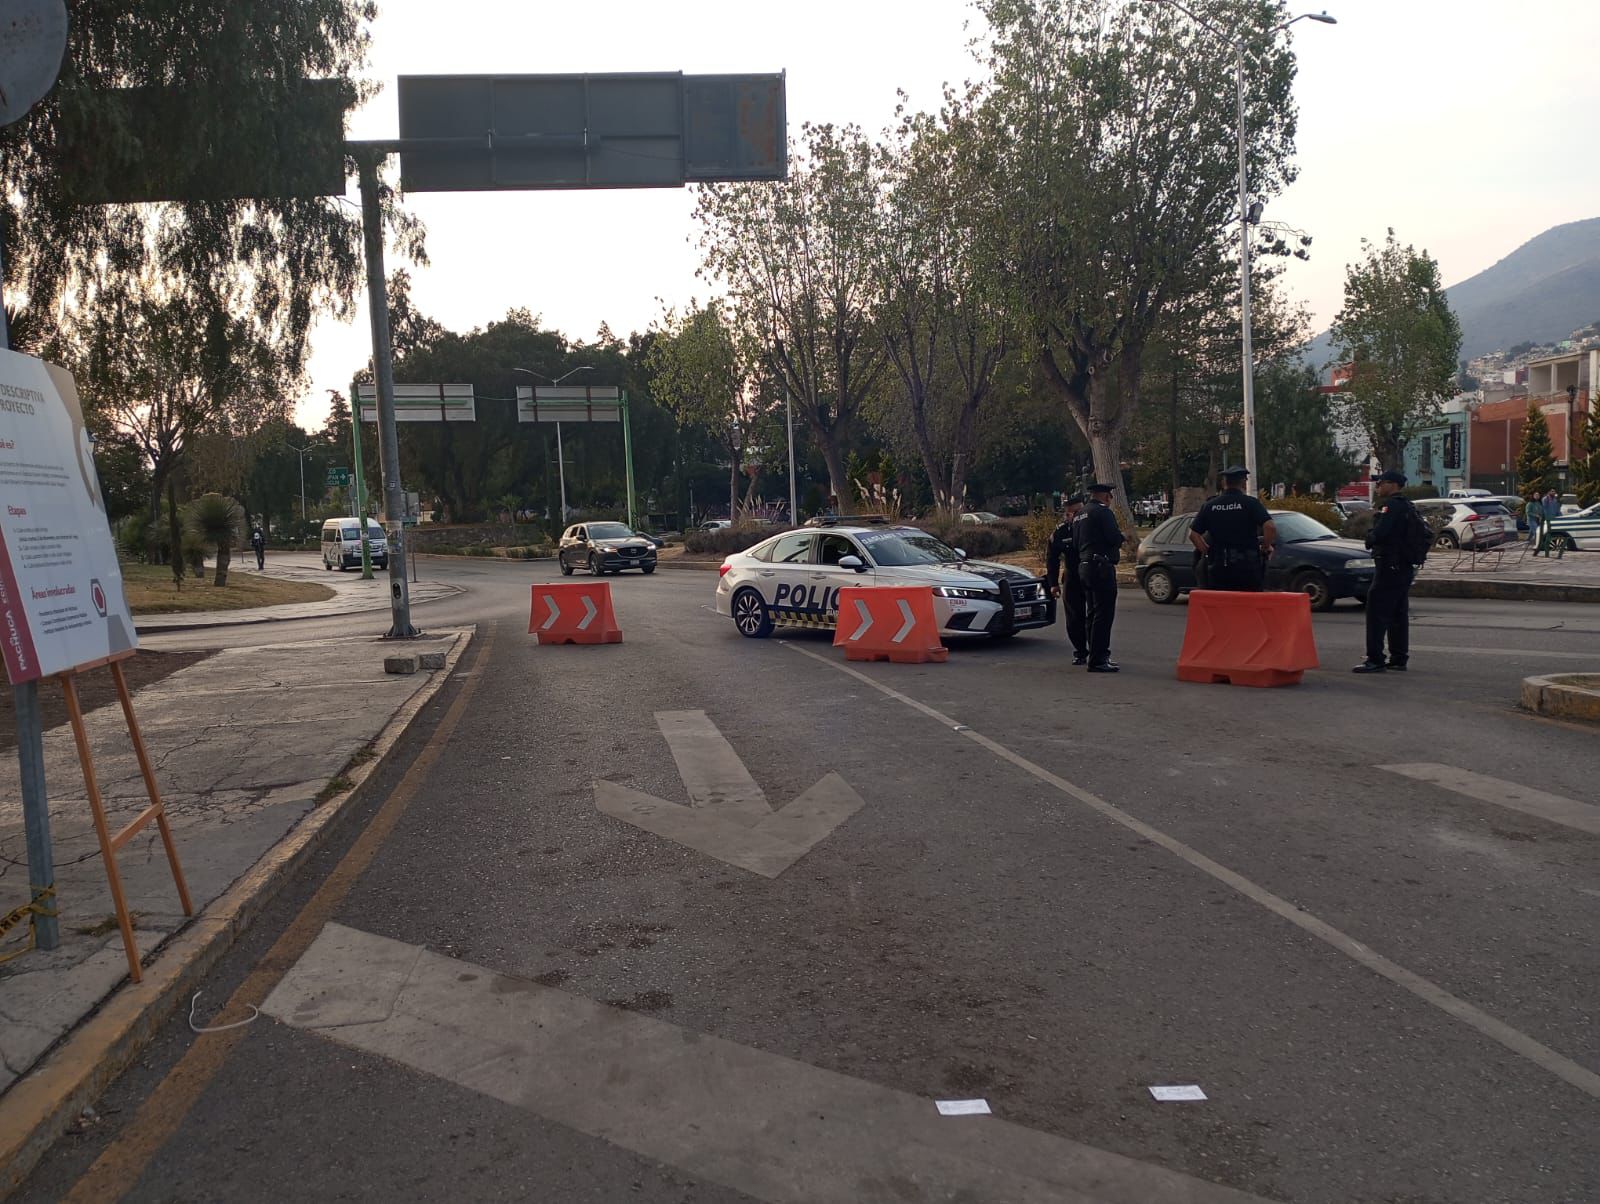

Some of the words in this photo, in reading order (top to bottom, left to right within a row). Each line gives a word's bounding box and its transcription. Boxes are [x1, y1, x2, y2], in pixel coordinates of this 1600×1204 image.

[1211, 501, 1242, 512] POLICÍA
[774, 583, 840, 611] POLIC
[5, 610, 27, 671] PACHUCA
